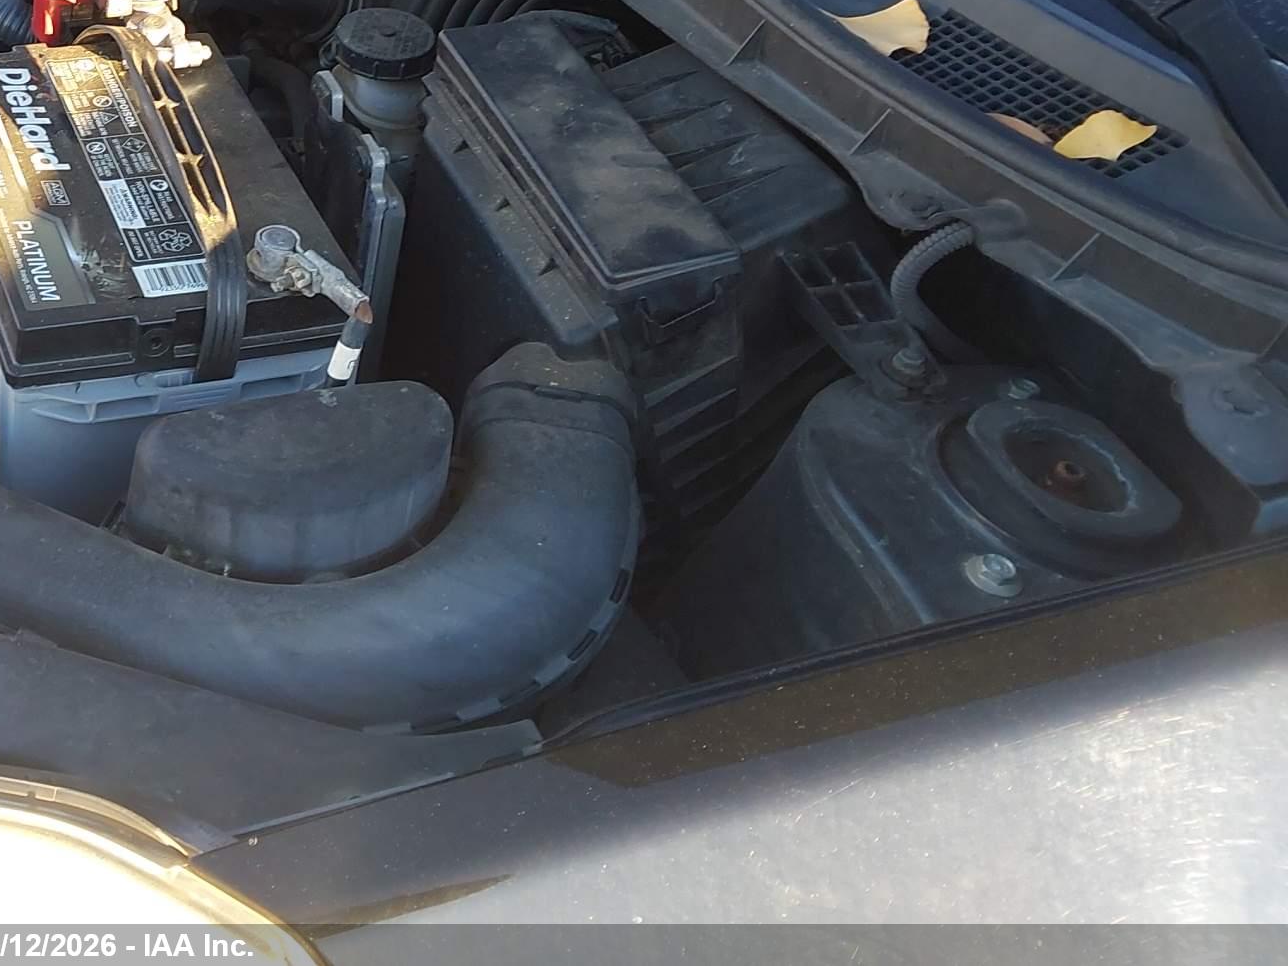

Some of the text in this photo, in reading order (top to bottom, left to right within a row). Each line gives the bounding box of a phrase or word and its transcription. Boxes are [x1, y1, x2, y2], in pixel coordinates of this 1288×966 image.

[103, 69, 137, 127] DANGER/POISON
[49, 183, 66, 204] AGM
[13, 220, 61, 301] PLATINUM
